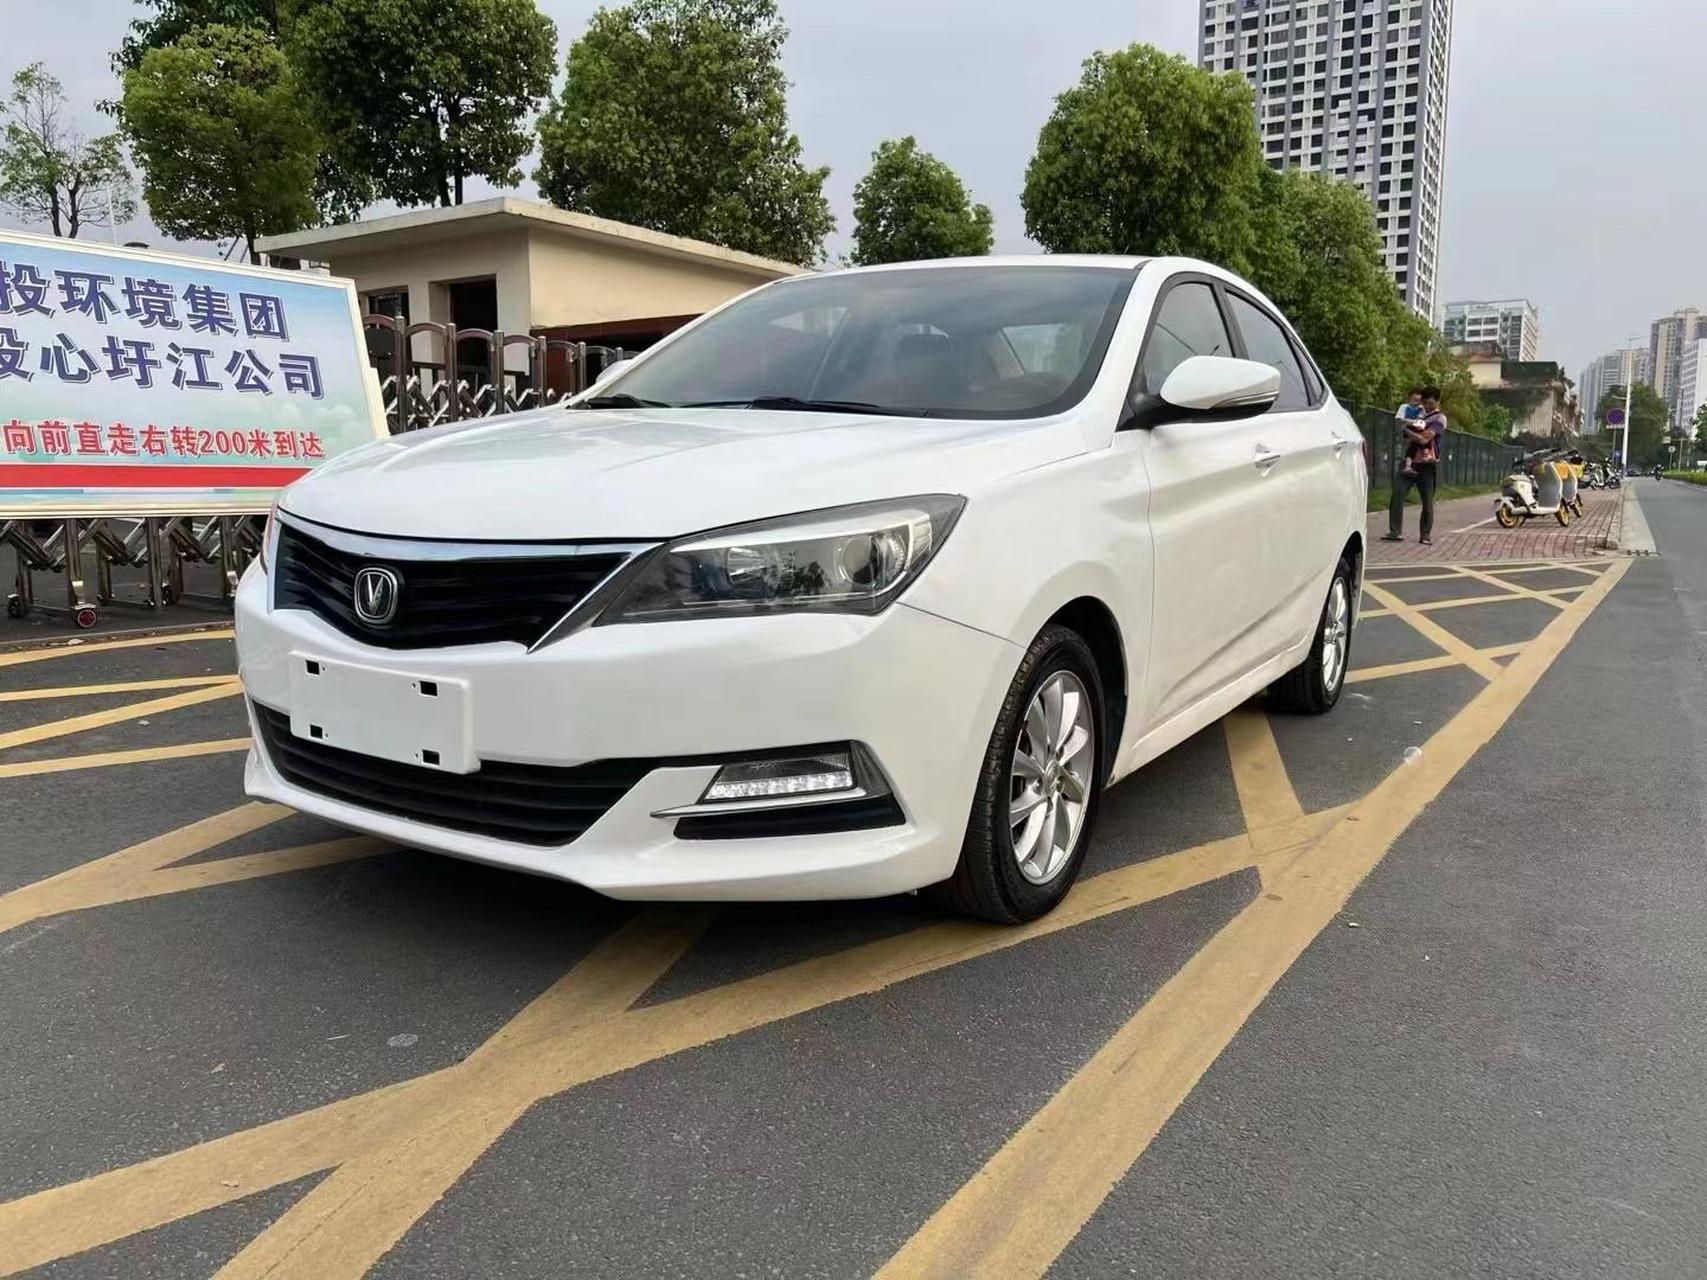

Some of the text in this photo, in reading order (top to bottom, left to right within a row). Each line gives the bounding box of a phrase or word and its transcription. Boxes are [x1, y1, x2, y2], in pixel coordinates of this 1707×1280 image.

[2, 419, 325, 459] 向前直走右转200米到达
